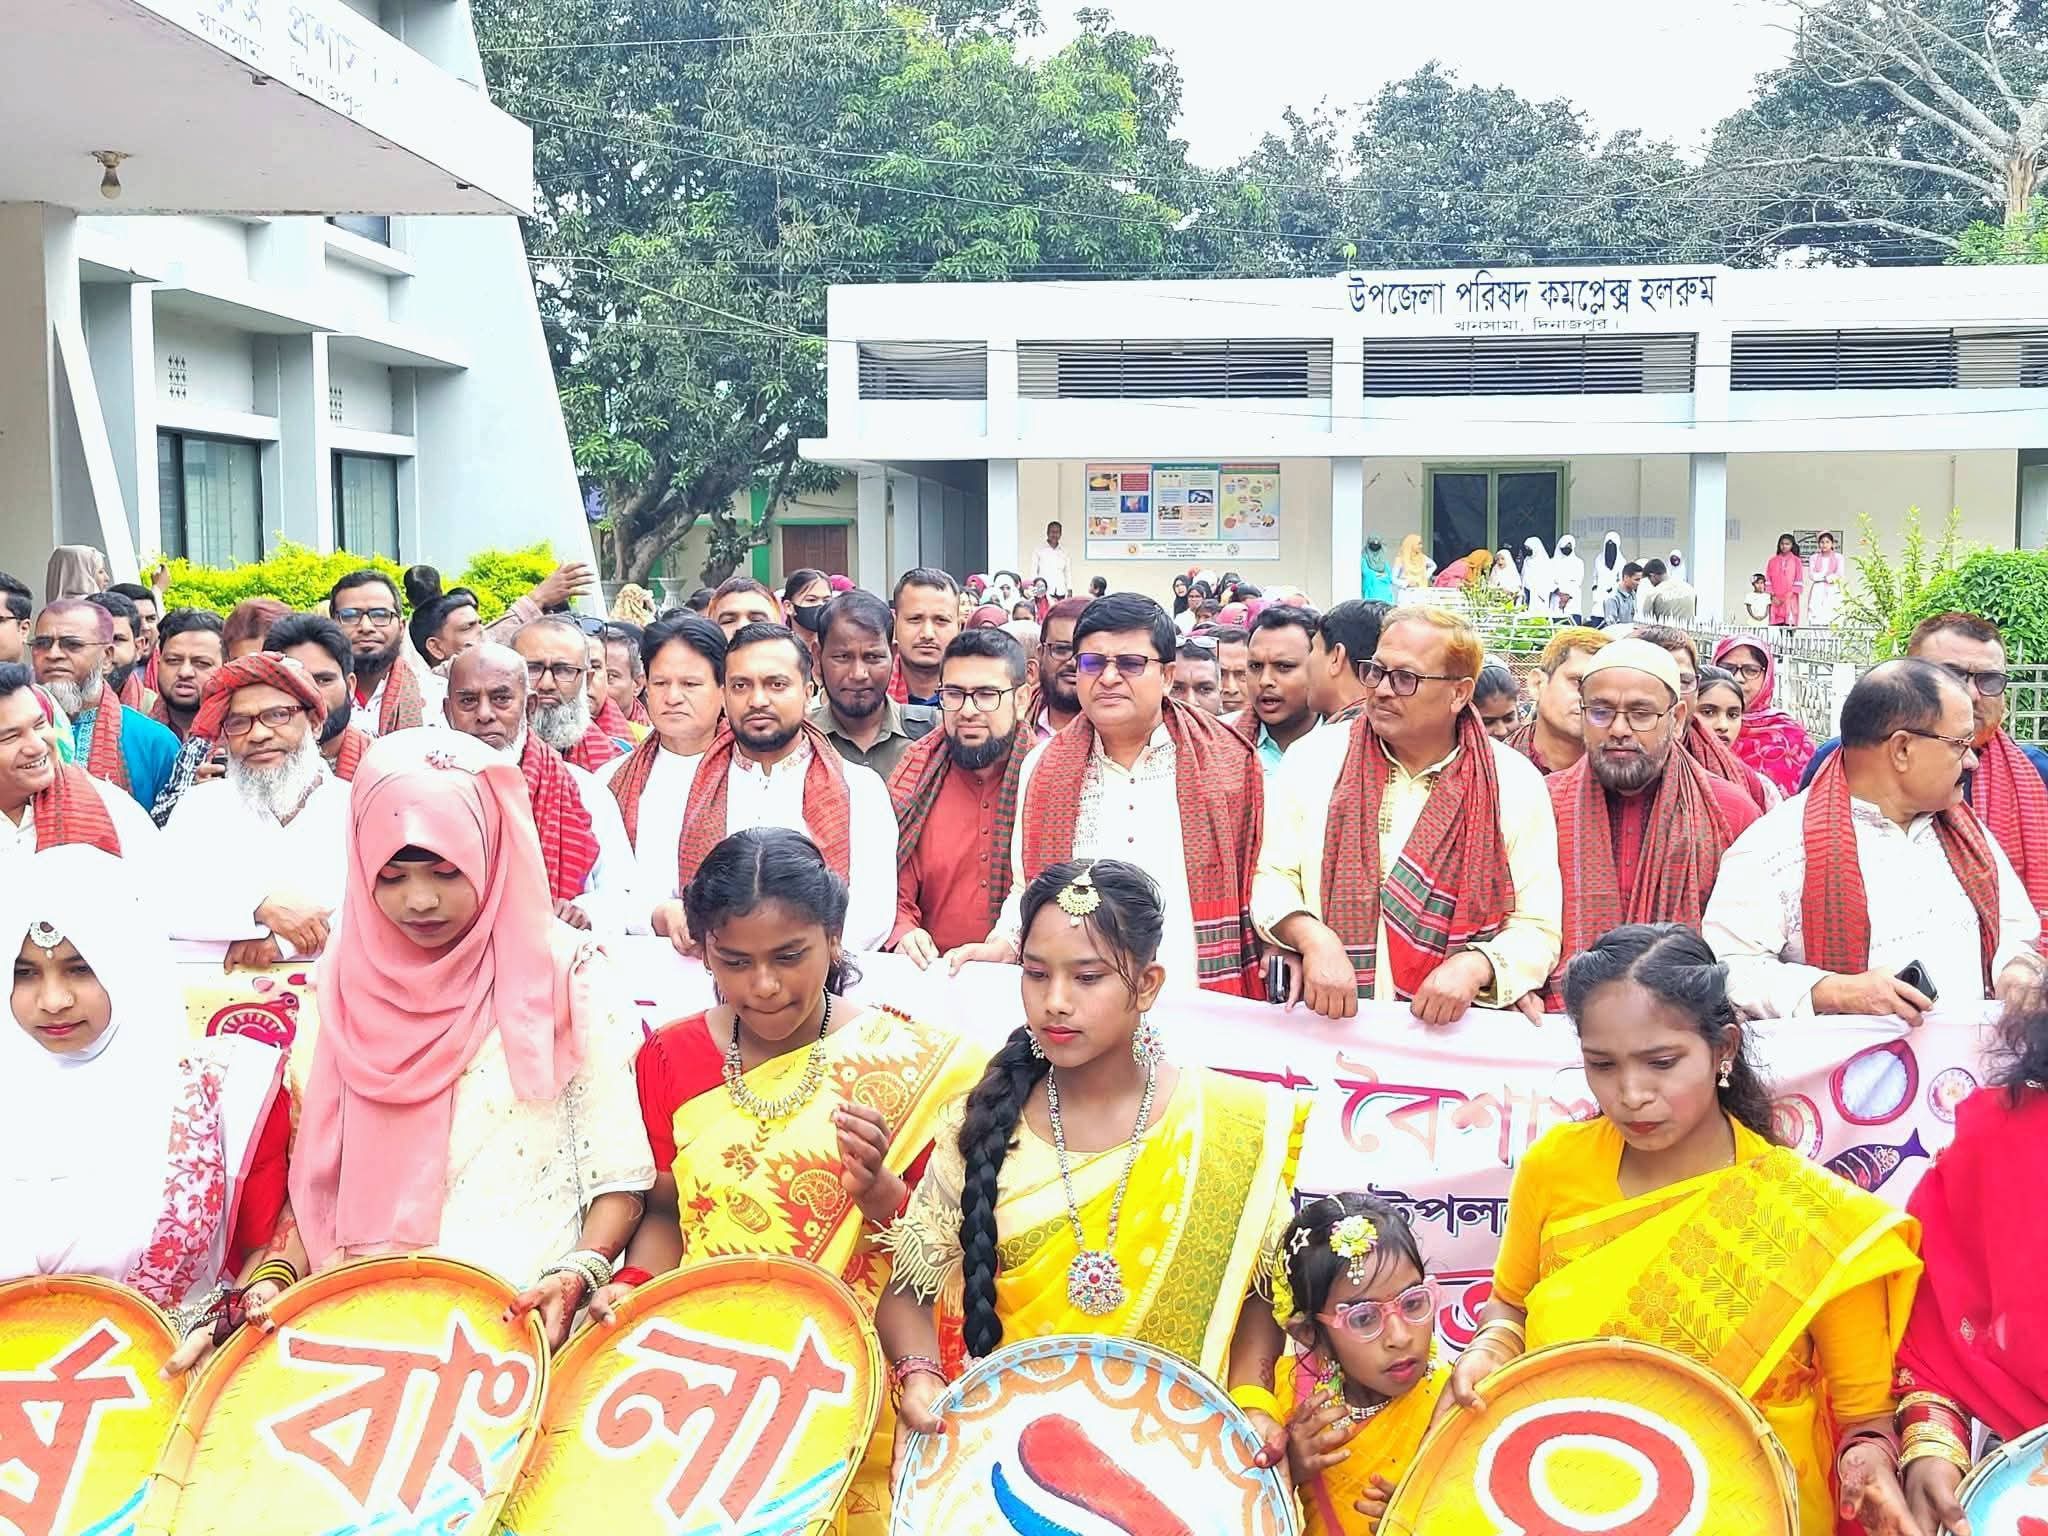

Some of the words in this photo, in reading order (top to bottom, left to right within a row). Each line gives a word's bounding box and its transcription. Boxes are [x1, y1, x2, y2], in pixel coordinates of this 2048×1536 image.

[1347, 276, 1446, 314] উপজেলা
[1456, 269, 1530, 313] পরিষদ
[1638, 275, 1717, 312] হলরুম
